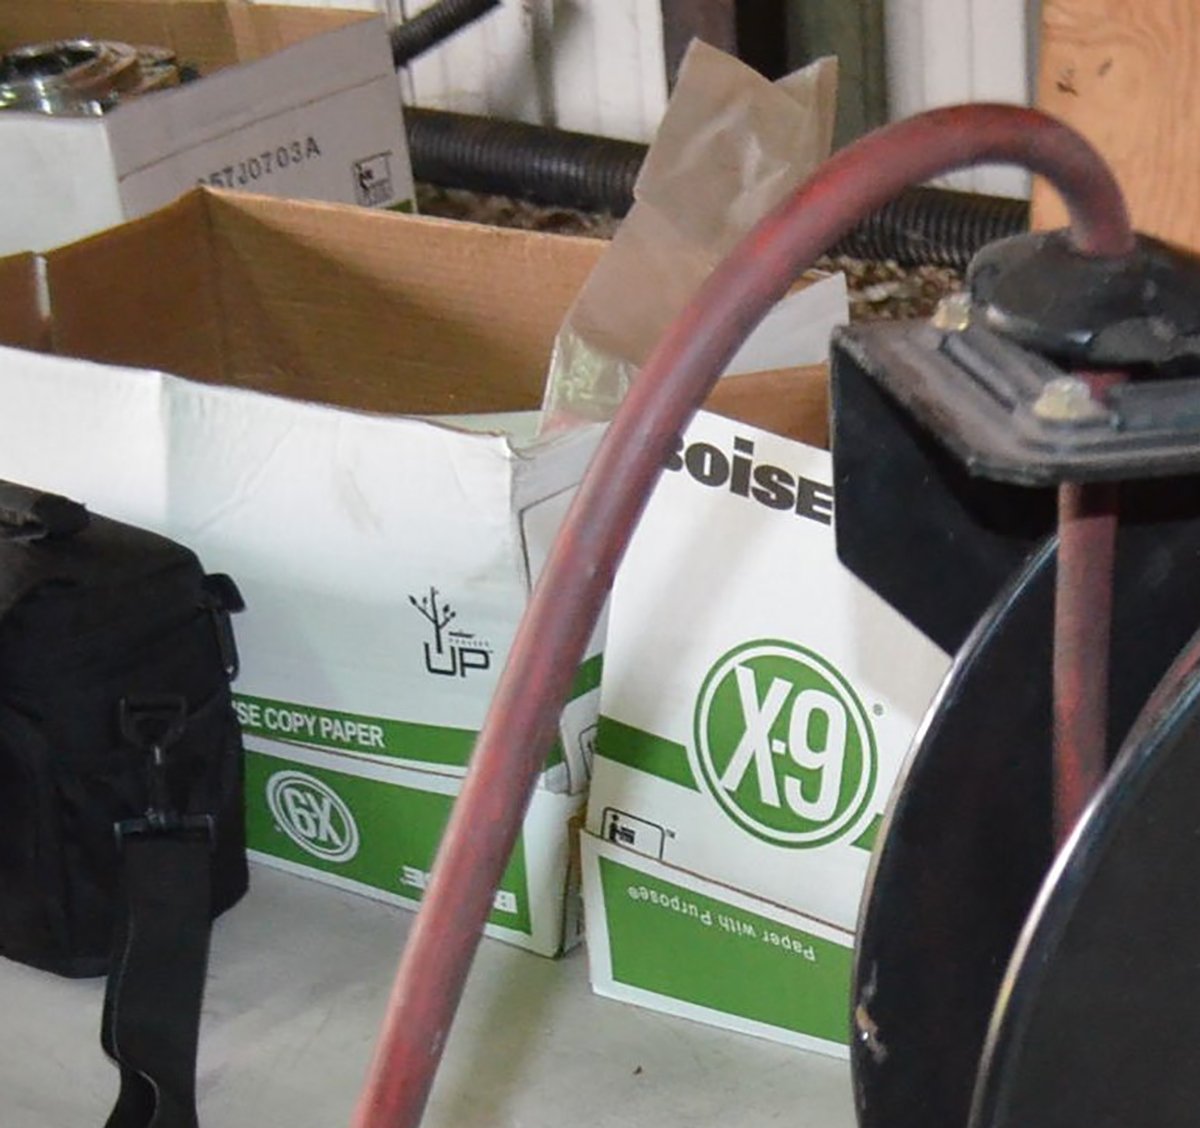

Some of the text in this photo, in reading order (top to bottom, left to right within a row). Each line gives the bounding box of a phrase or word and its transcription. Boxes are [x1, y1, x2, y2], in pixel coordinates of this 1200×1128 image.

[423, 641, 490, 678] UP
[264, 707, 317, 736] COPY
[320, 717, 385, 748] PAPER
[720, 664, 848, 822] X-9
[719, 912, 757, 937] with
[762, 930, 816, 961] Paper
